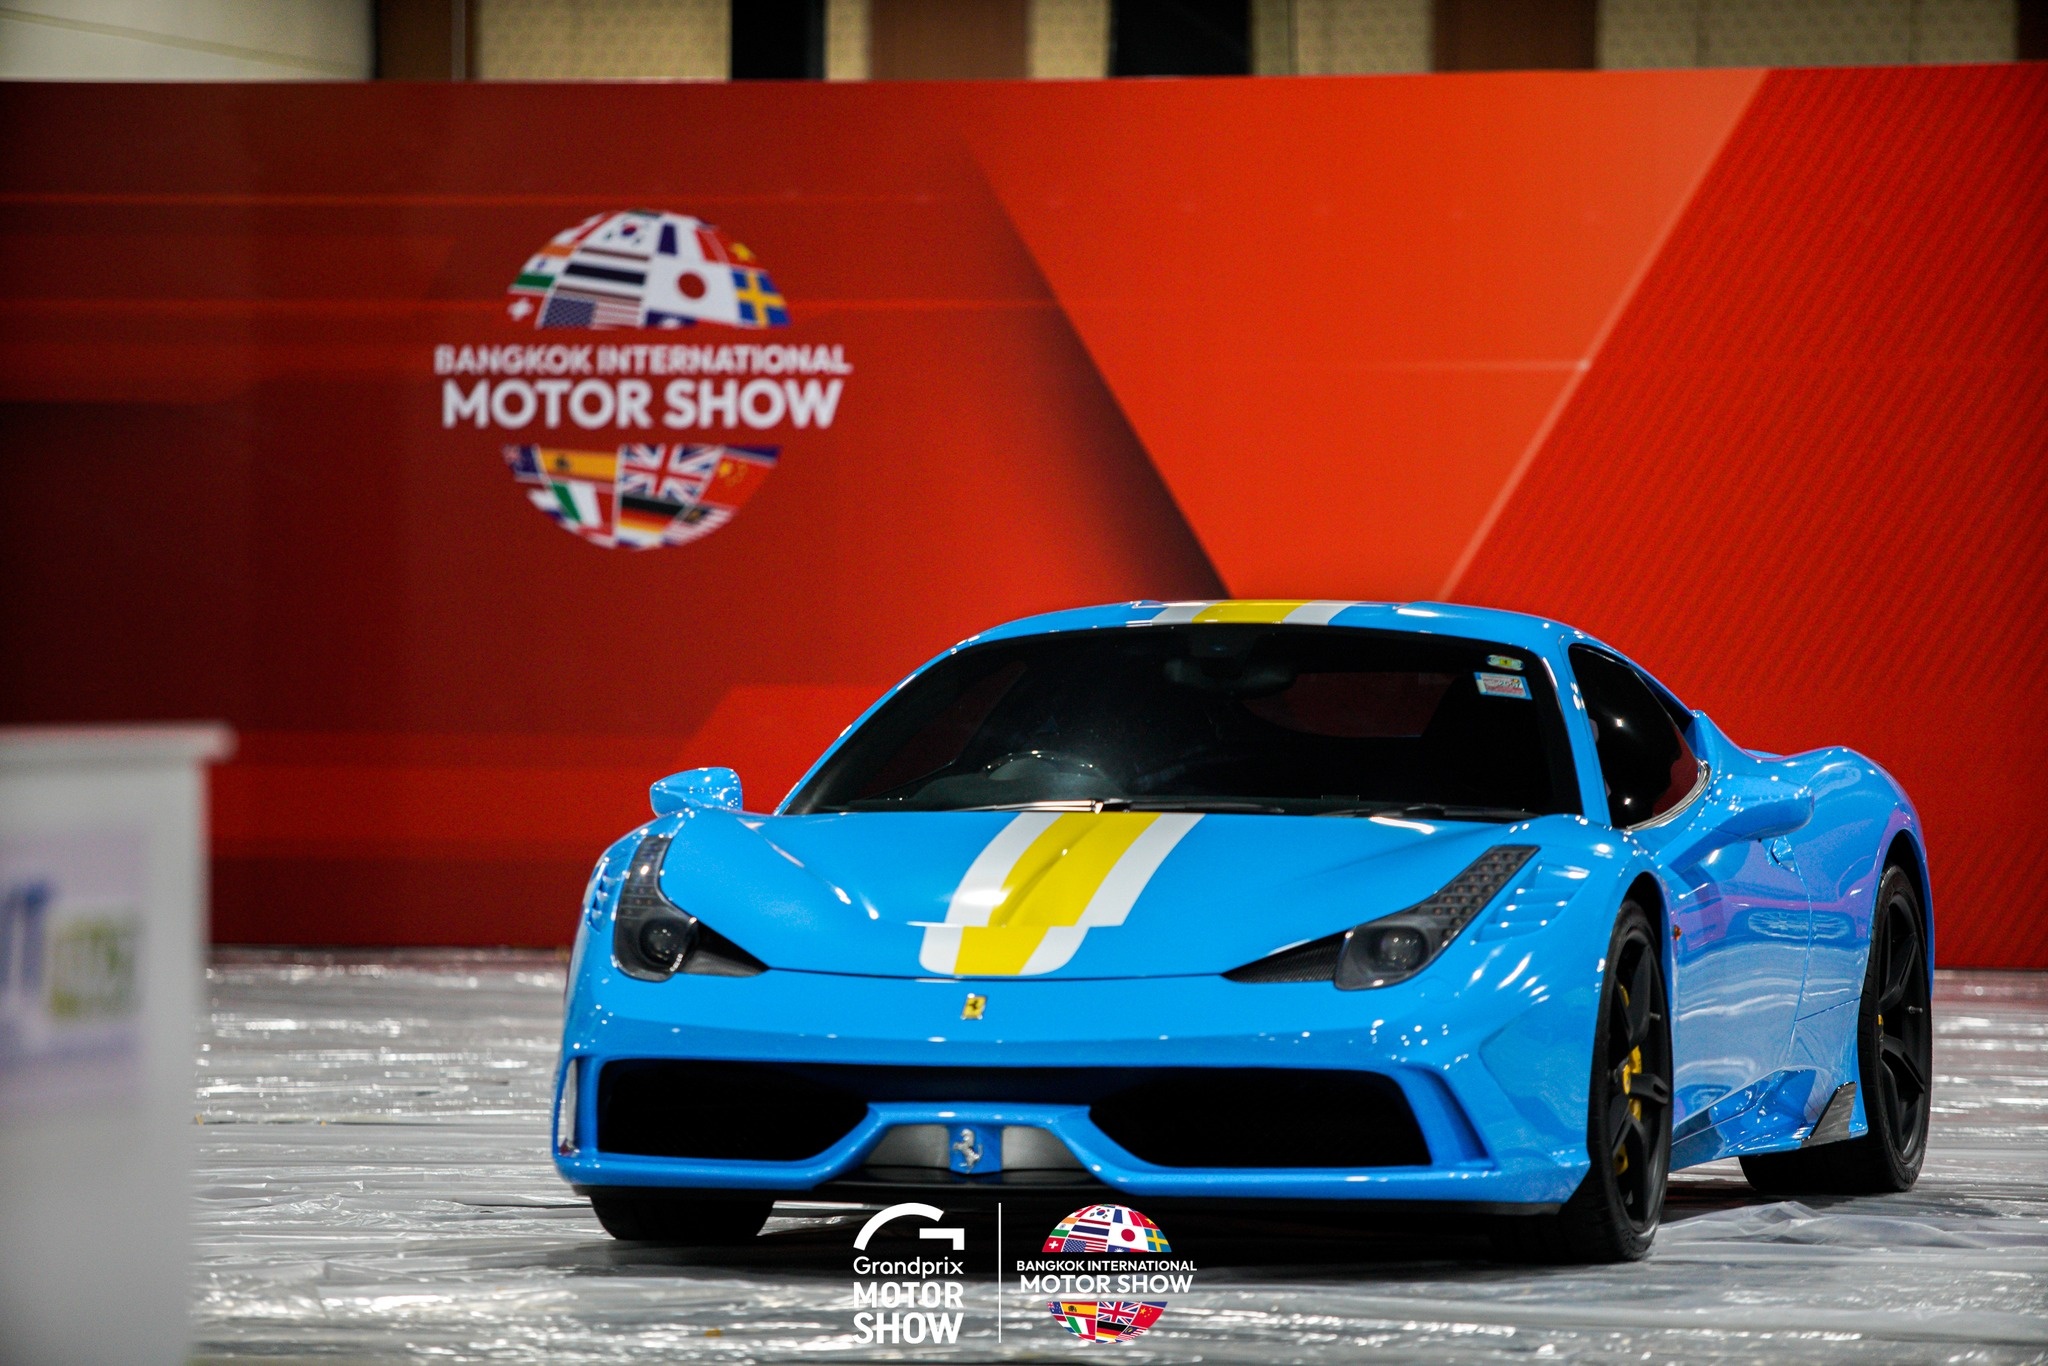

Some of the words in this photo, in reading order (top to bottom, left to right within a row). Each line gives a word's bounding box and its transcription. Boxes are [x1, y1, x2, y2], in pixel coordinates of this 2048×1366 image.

[435, 344, 593, 374] BANGKOK
[599, 344, 852, 375] INTERNATIONAL
[442, 378, 652, 429] MOTOR
[663, 378, 844, 429] SHOW
